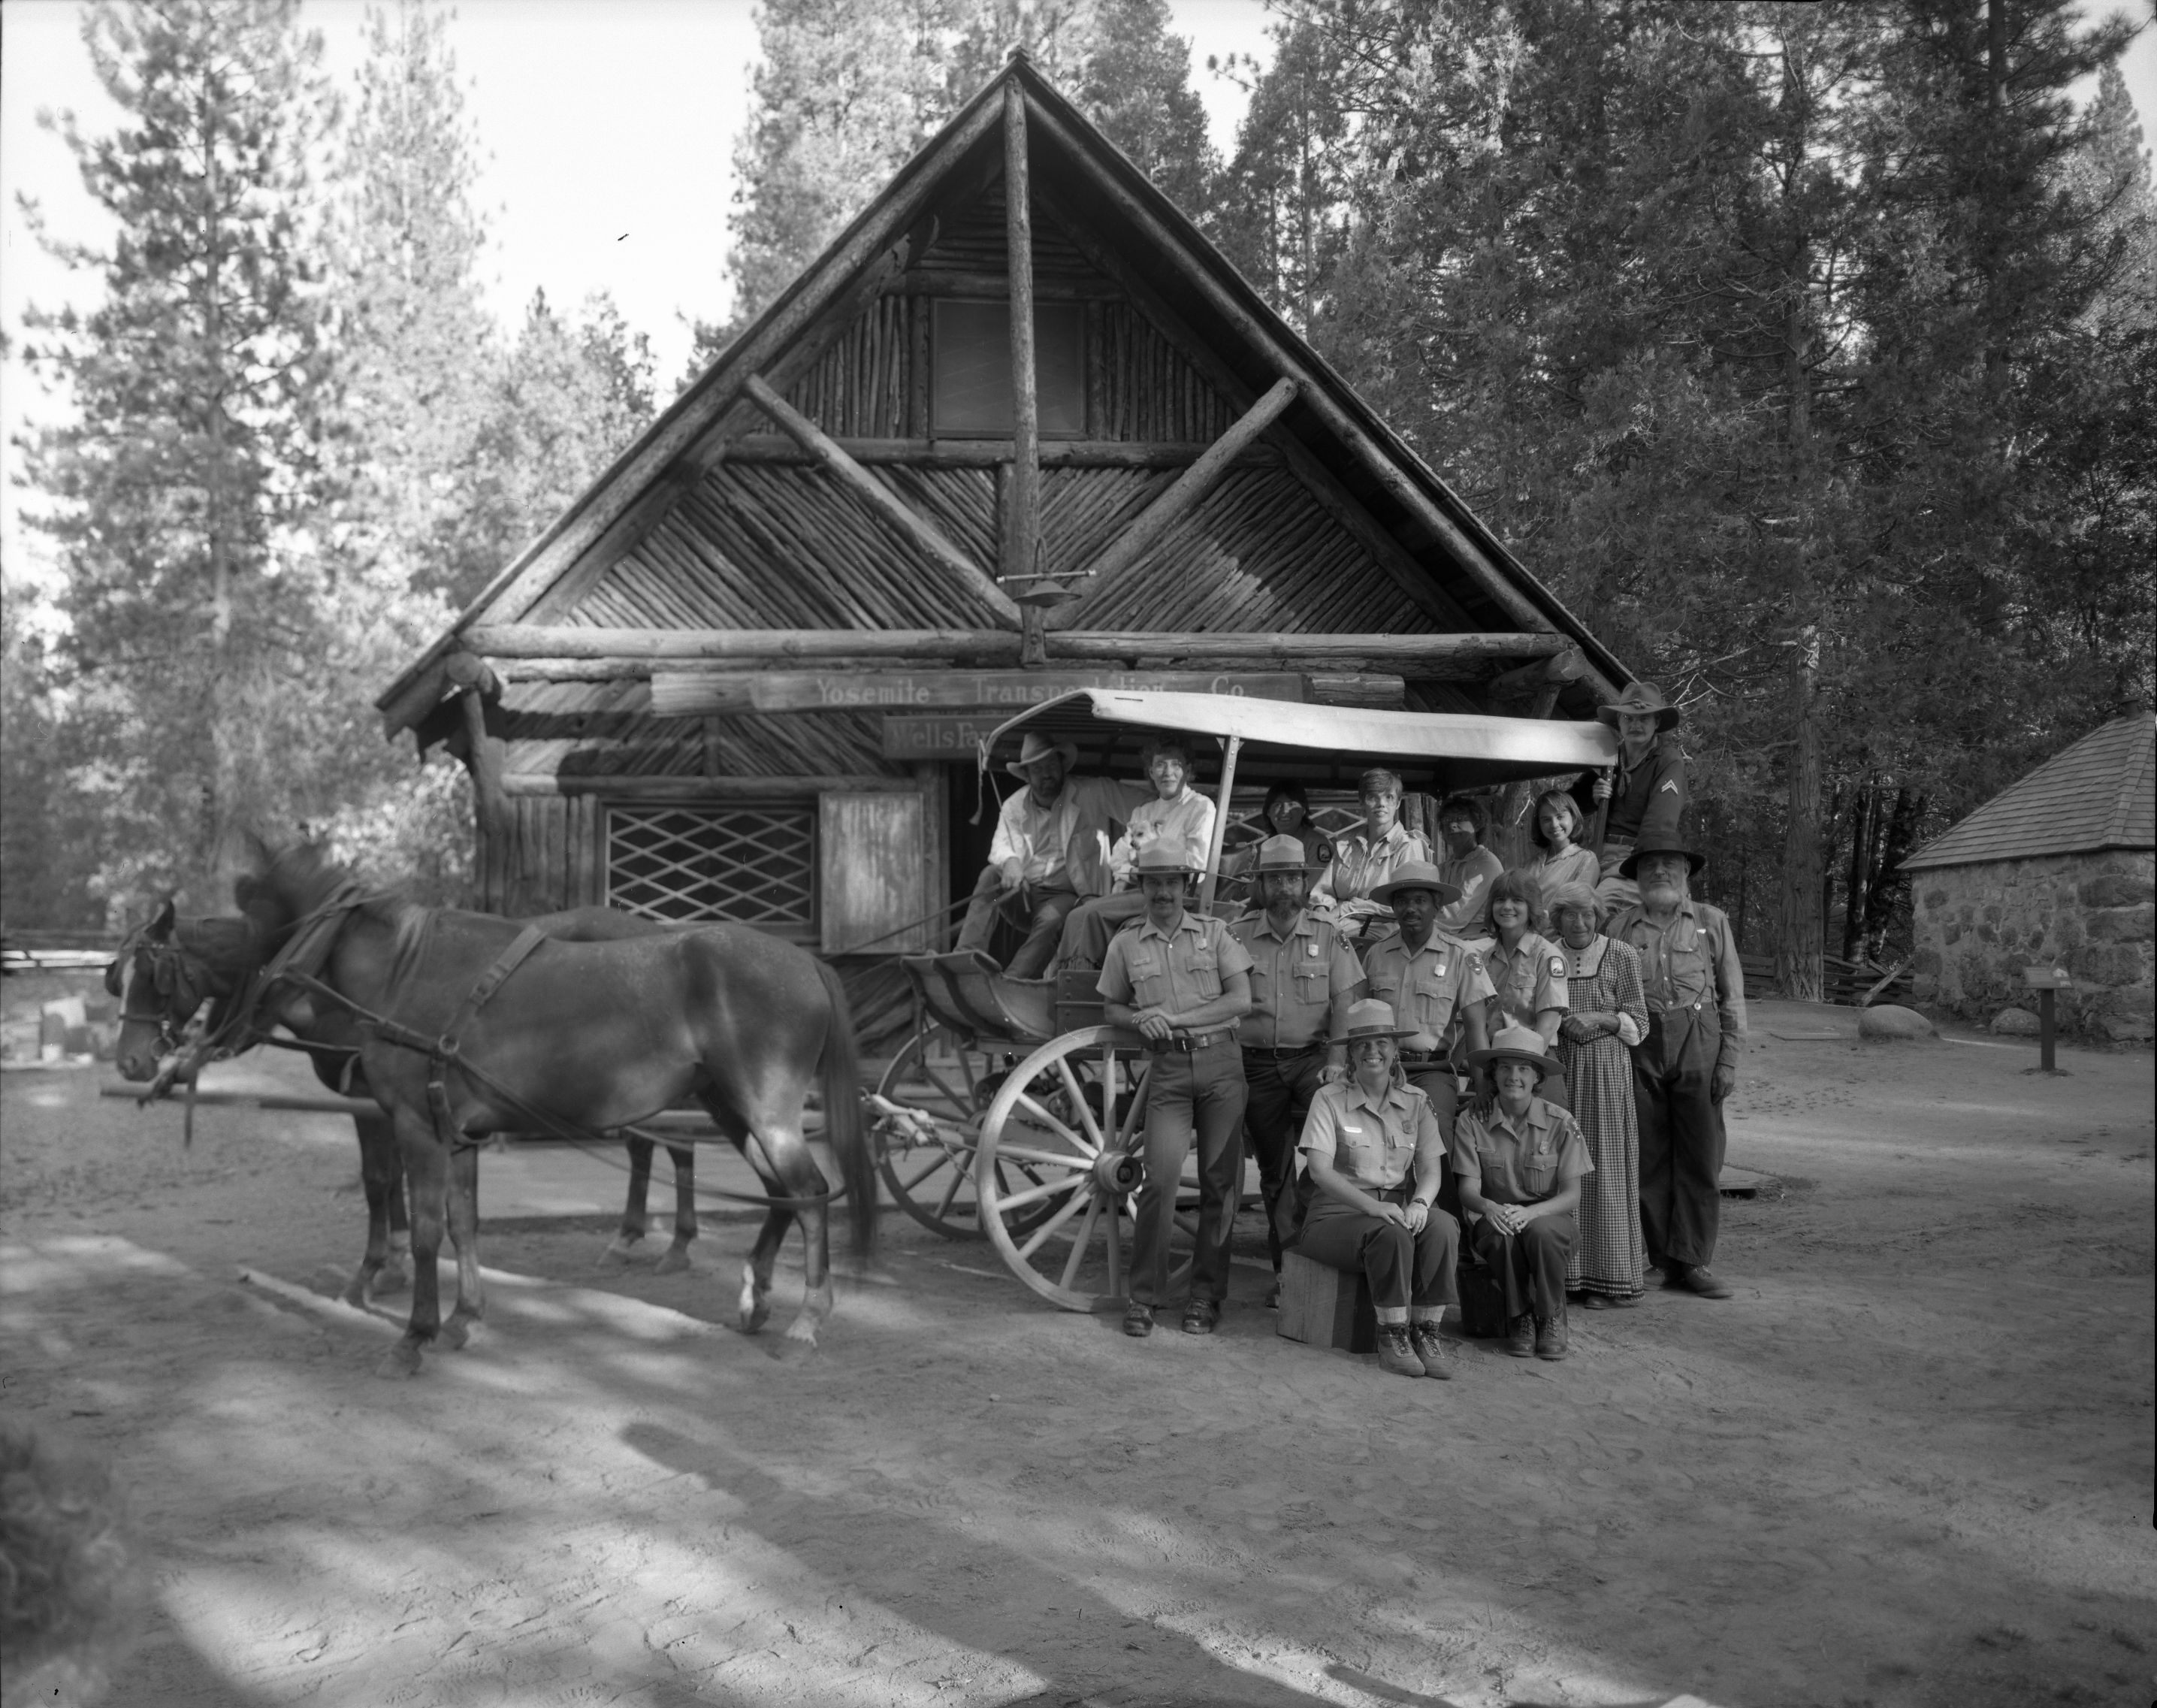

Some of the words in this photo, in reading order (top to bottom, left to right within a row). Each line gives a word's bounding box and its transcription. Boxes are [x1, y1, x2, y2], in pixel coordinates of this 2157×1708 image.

[817, 676, 930, 705] Yosemite
[971, 674, 1164, 703] Transptti
[890, 721, 955, 748] Wells
